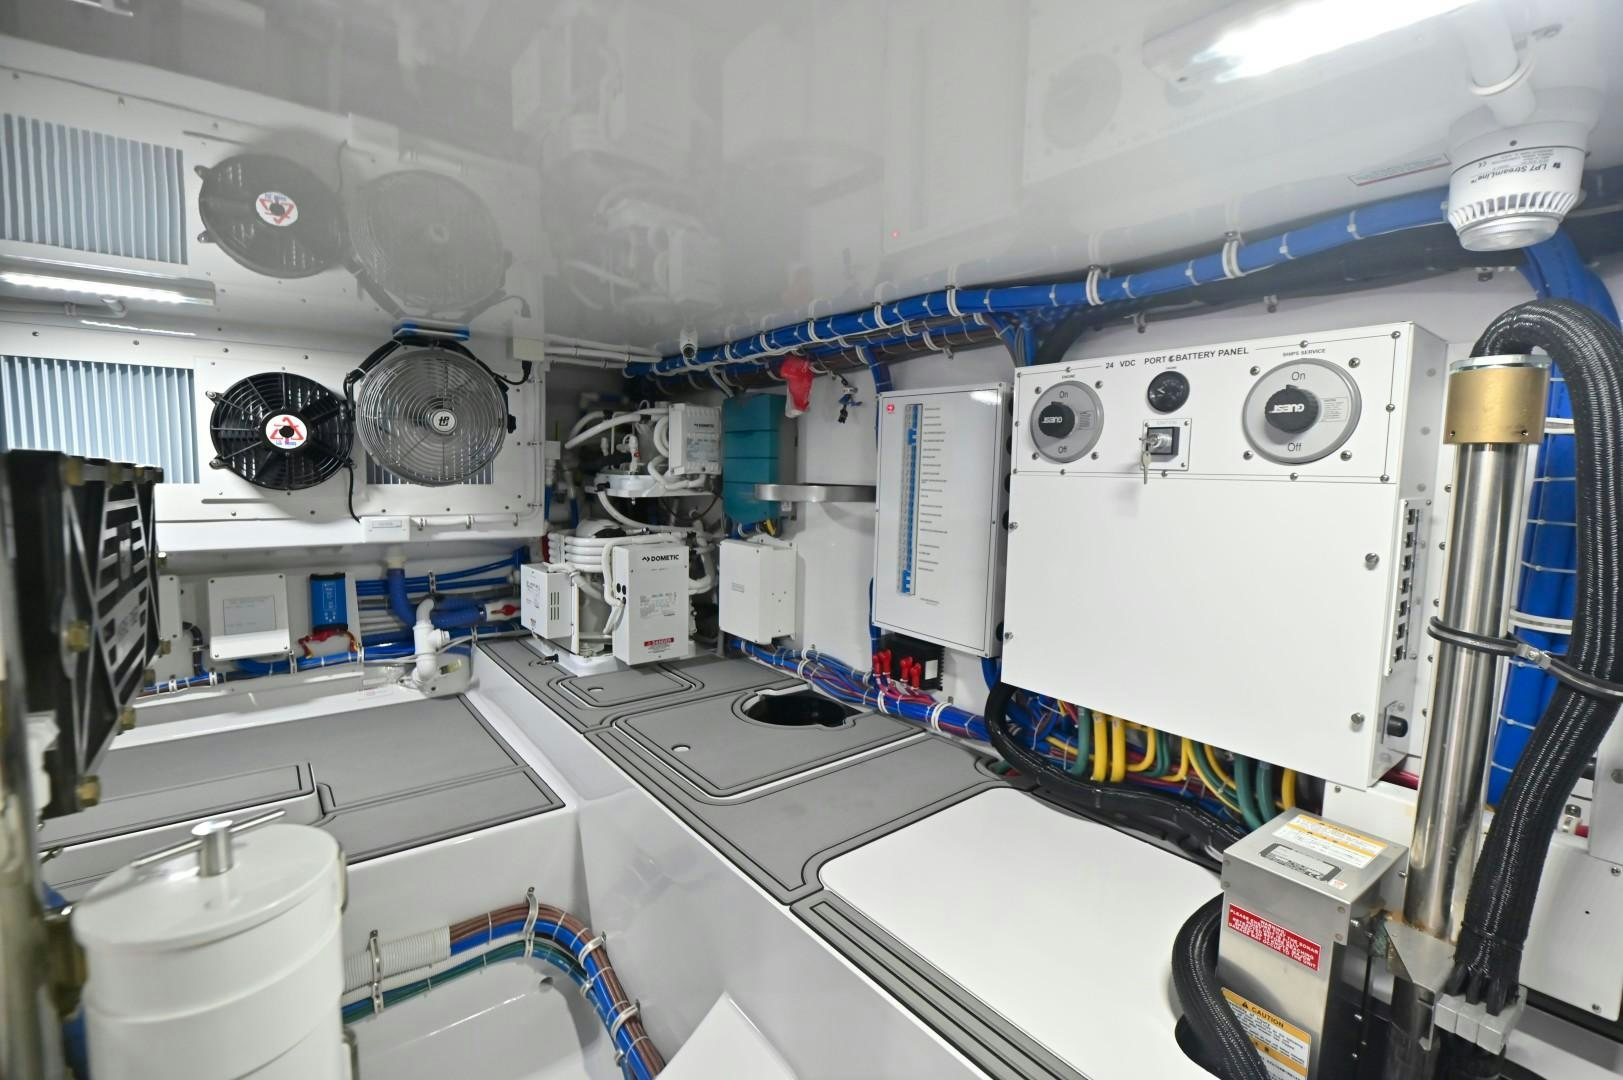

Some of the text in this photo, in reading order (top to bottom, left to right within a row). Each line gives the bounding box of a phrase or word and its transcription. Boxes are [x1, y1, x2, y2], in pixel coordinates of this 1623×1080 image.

[1144, 356, 1167, 364] PORT
[1176, 350, 1216, 362] BATTERY
[1218, 346, 1249, 356] PANEL
[1292, 371, 1306, 381] On
[1059, 390, 1068, 399] On
[1268, 403, 1305, 414] GUEST
[1058, 446, 1068, 454] Off
[1287, 442, 1302, 452] Off
[650, 554, 680, 562] DOMETIC
[1230, 908, 1248, 920] PLEASE
[1299, 941, 1318, 954] SONAR
[1302, 958, 1317, 969] UNIT
[1252, 1008, 1284, 1028] CAUTION
